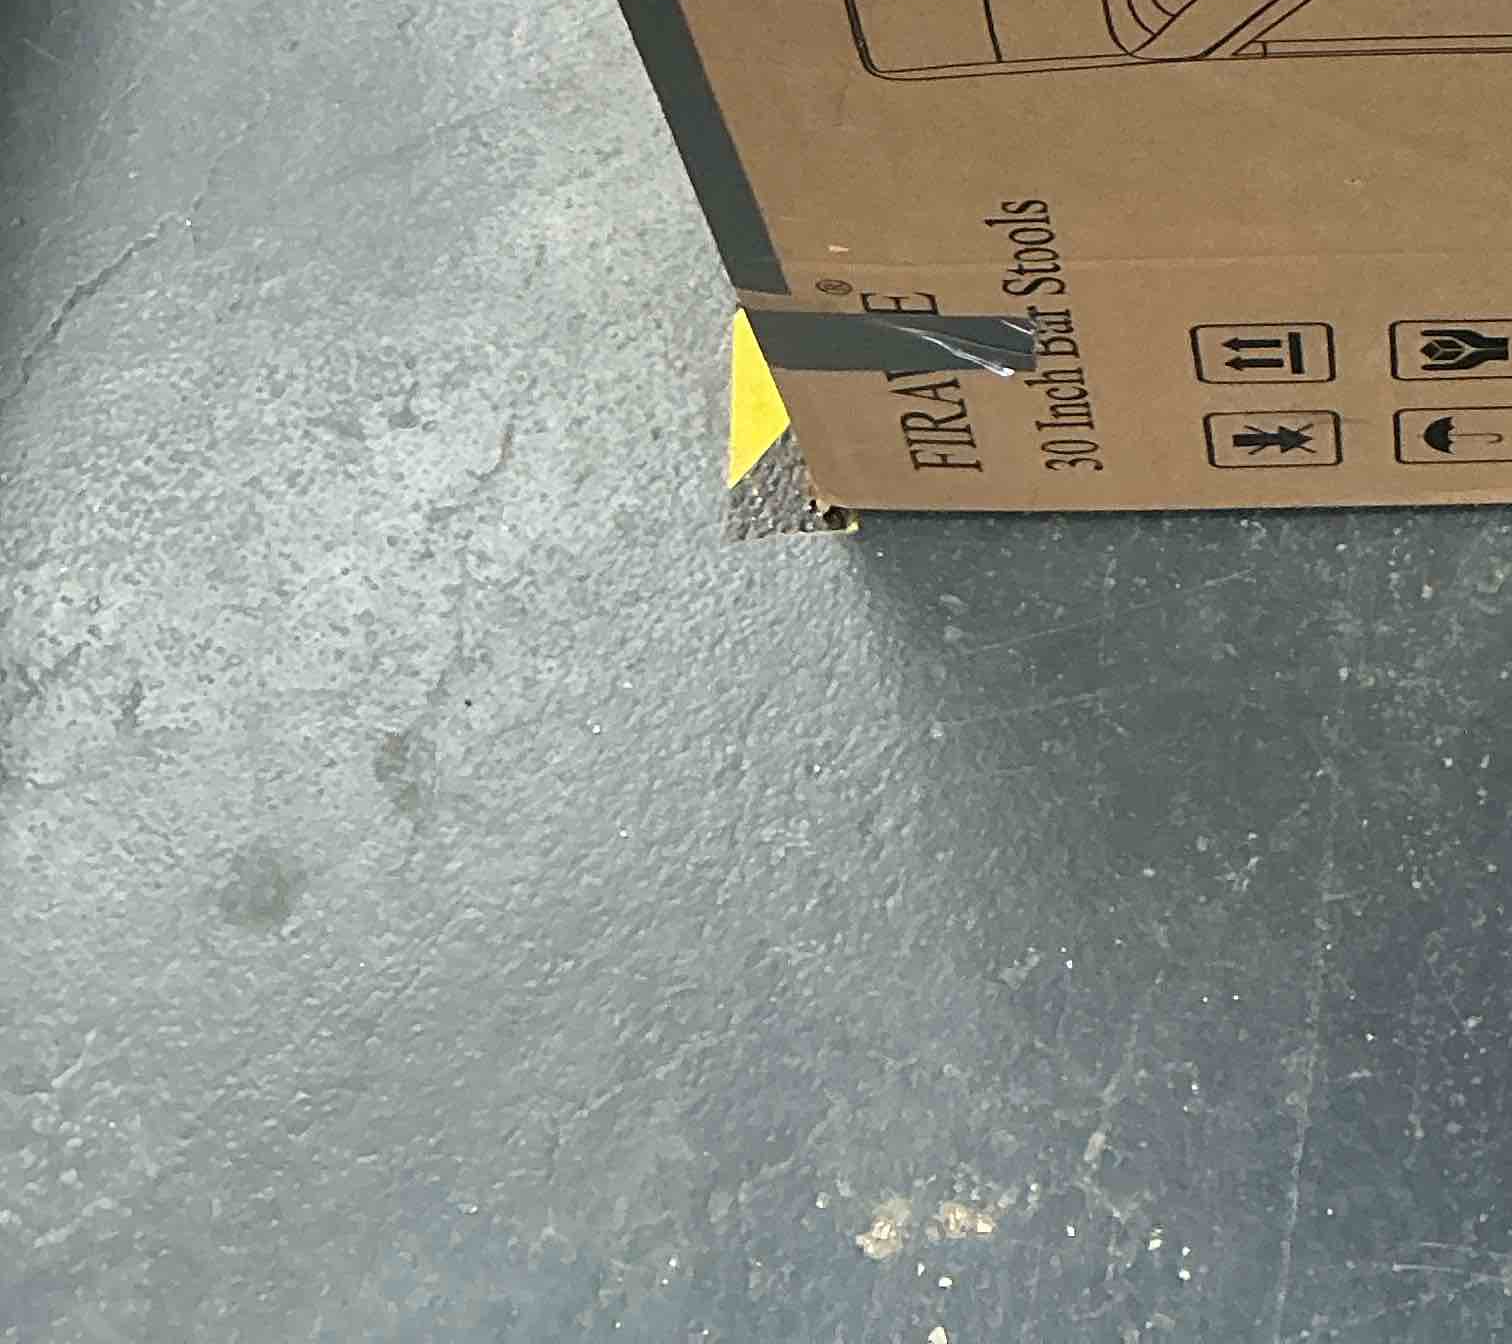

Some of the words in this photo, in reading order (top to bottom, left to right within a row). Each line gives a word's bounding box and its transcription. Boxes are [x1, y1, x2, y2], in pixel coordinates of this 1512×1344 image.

[984, 198, 1067, 296] Stools
[1026, 305, 1080, 359] Bar
[1023, 367, 1095, 431] Inch
[1040, 438, 1104, 472] 30
